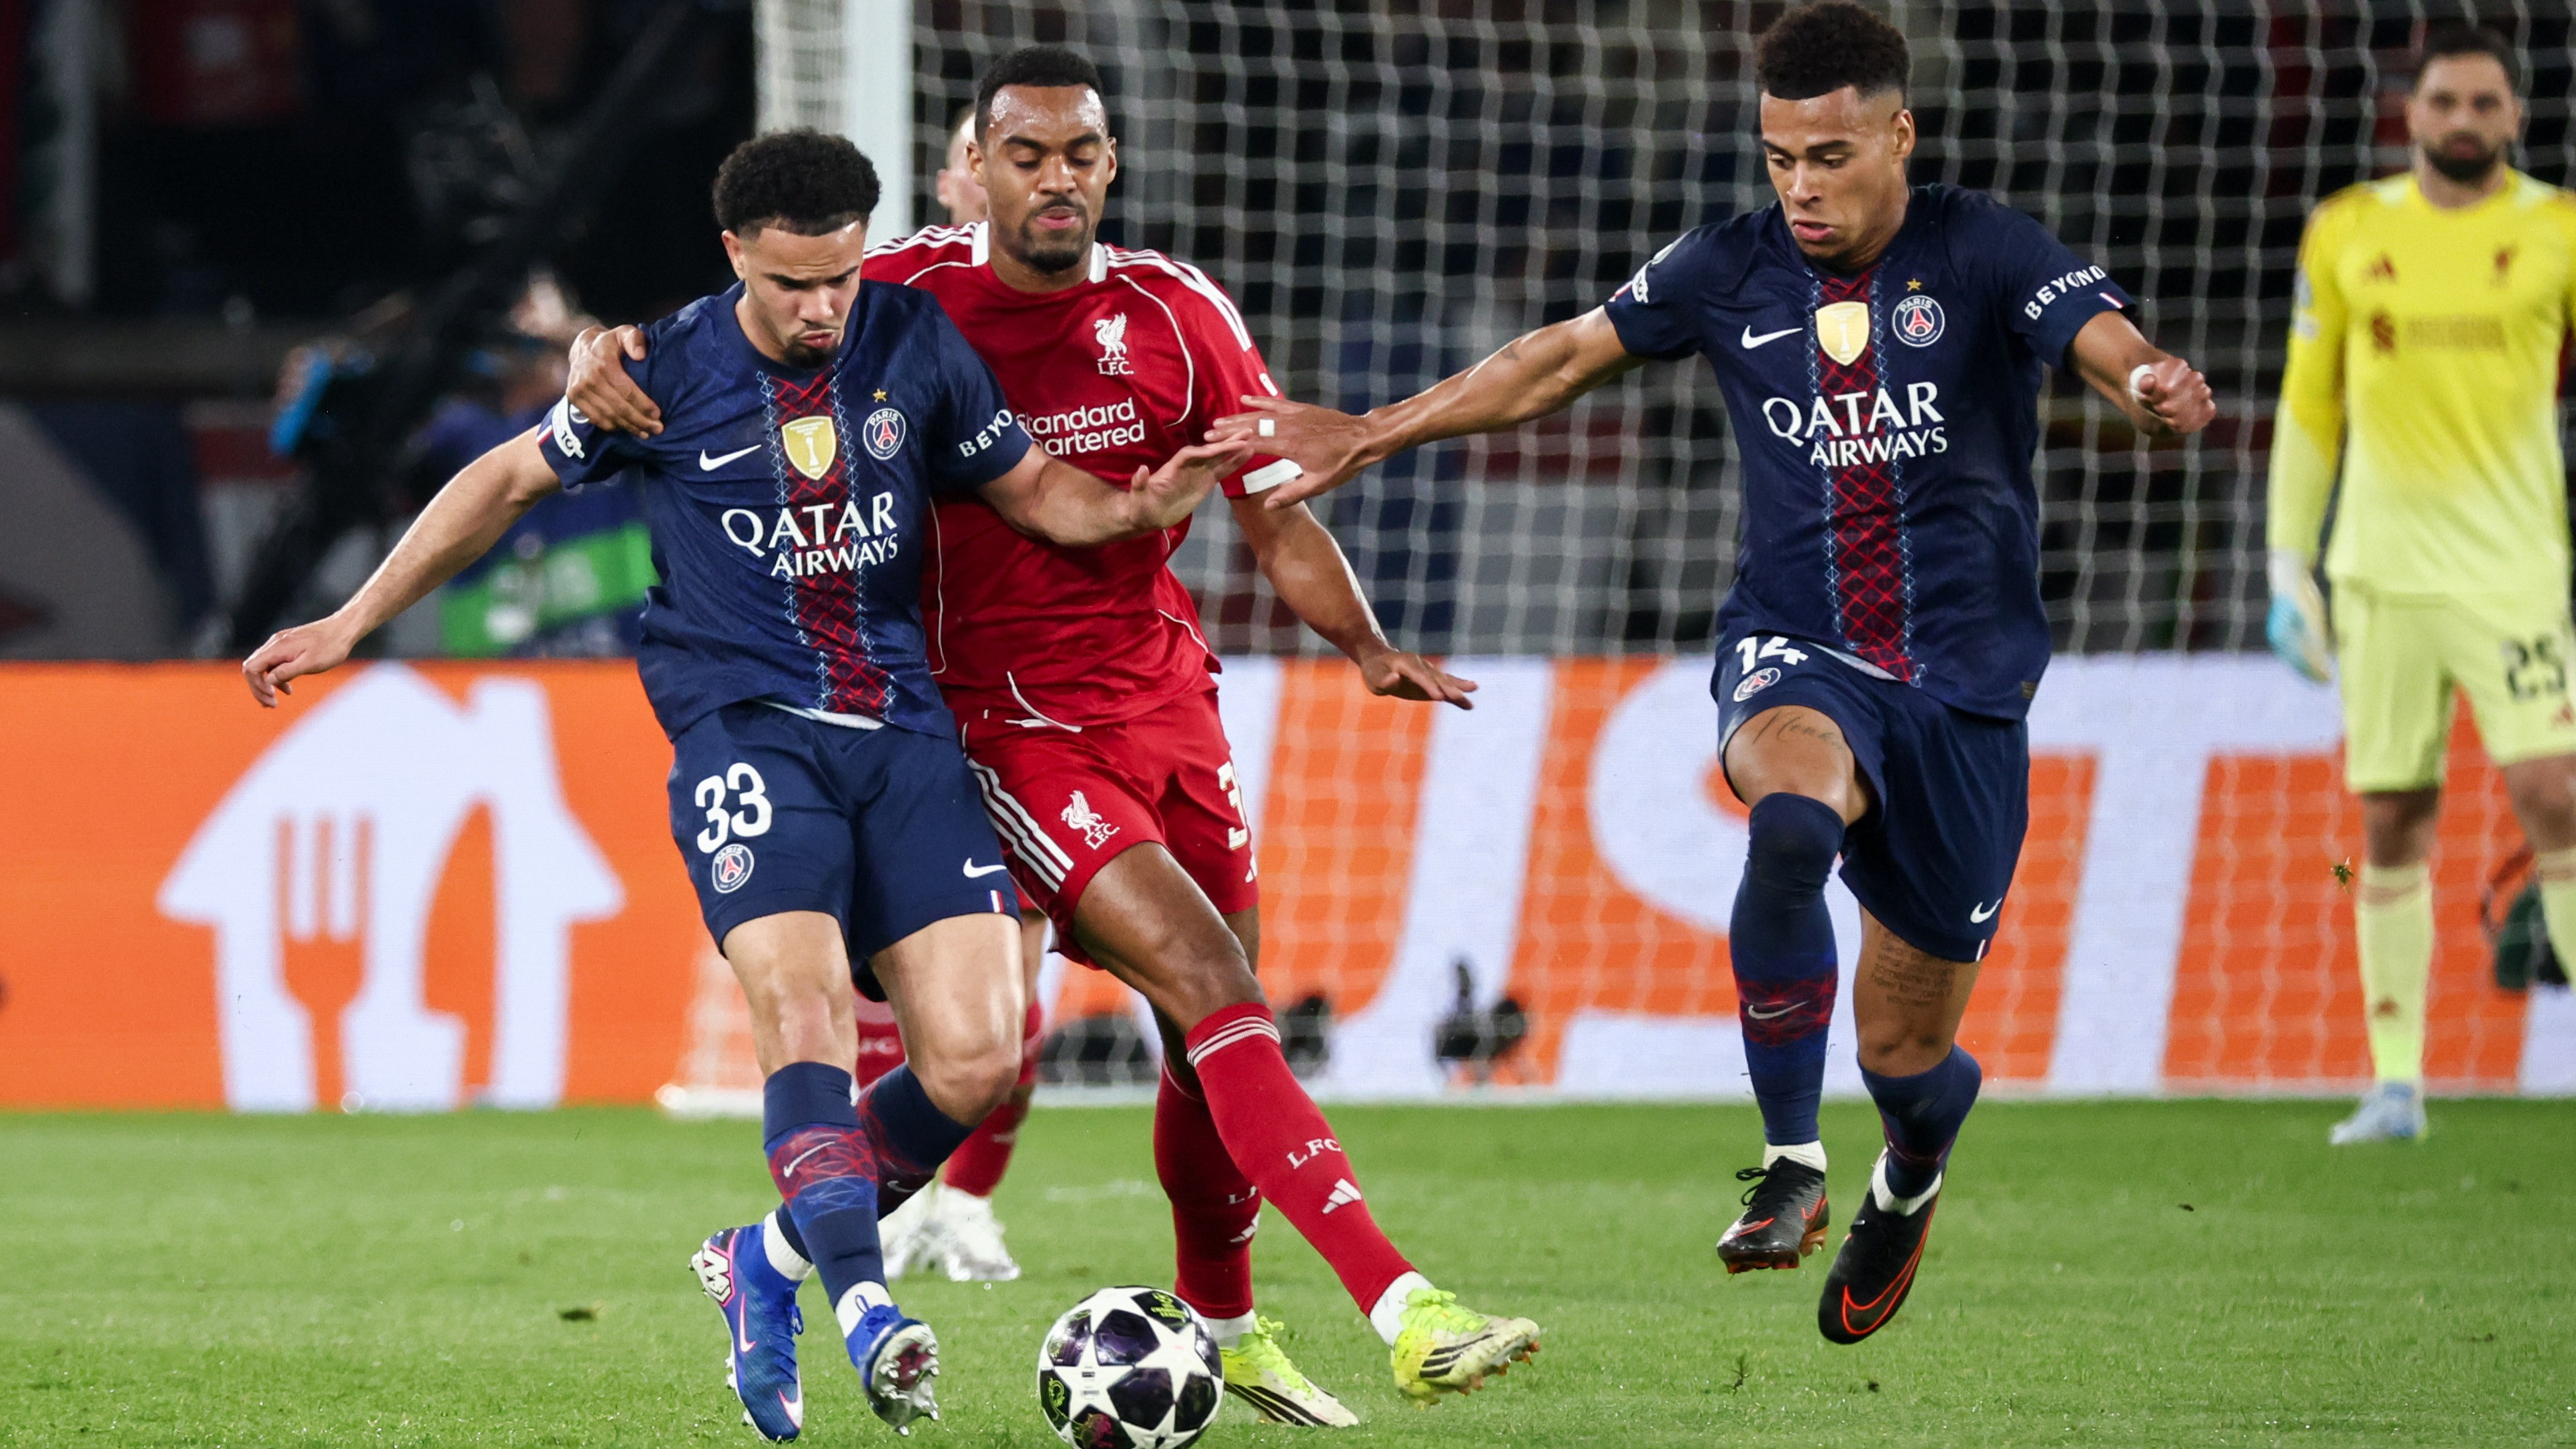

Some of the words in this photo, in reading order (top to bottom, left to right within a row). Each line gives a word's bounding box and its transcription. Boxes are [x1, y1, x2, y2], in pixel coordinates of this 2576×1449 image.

[1899, 298, 1933, 312] PARIS
[2024, 265, 2106, 320] BEYOND
[869, 410, 899, 426] PARIS
[958, 409, 1013, 458] BEYO
[1762, 381, 1945, 447] QATAR
[1033, 418, 1145, 456] artered
[1810, 426, 1948, 466] AIRWAYS
[721, 492, 897, 558] QATAR
[771, 533, 898, 576] AIRWAYS
[1736, 636, 1809, 675] 14
[2501, 635, 2567, 702] 25
[695, 762, 773, 854] 33
[1217, 753, 1248, 851] 3
[715, 846, 744, 864] PARIS
[1286, 1138, 1342, 1169] LFC
